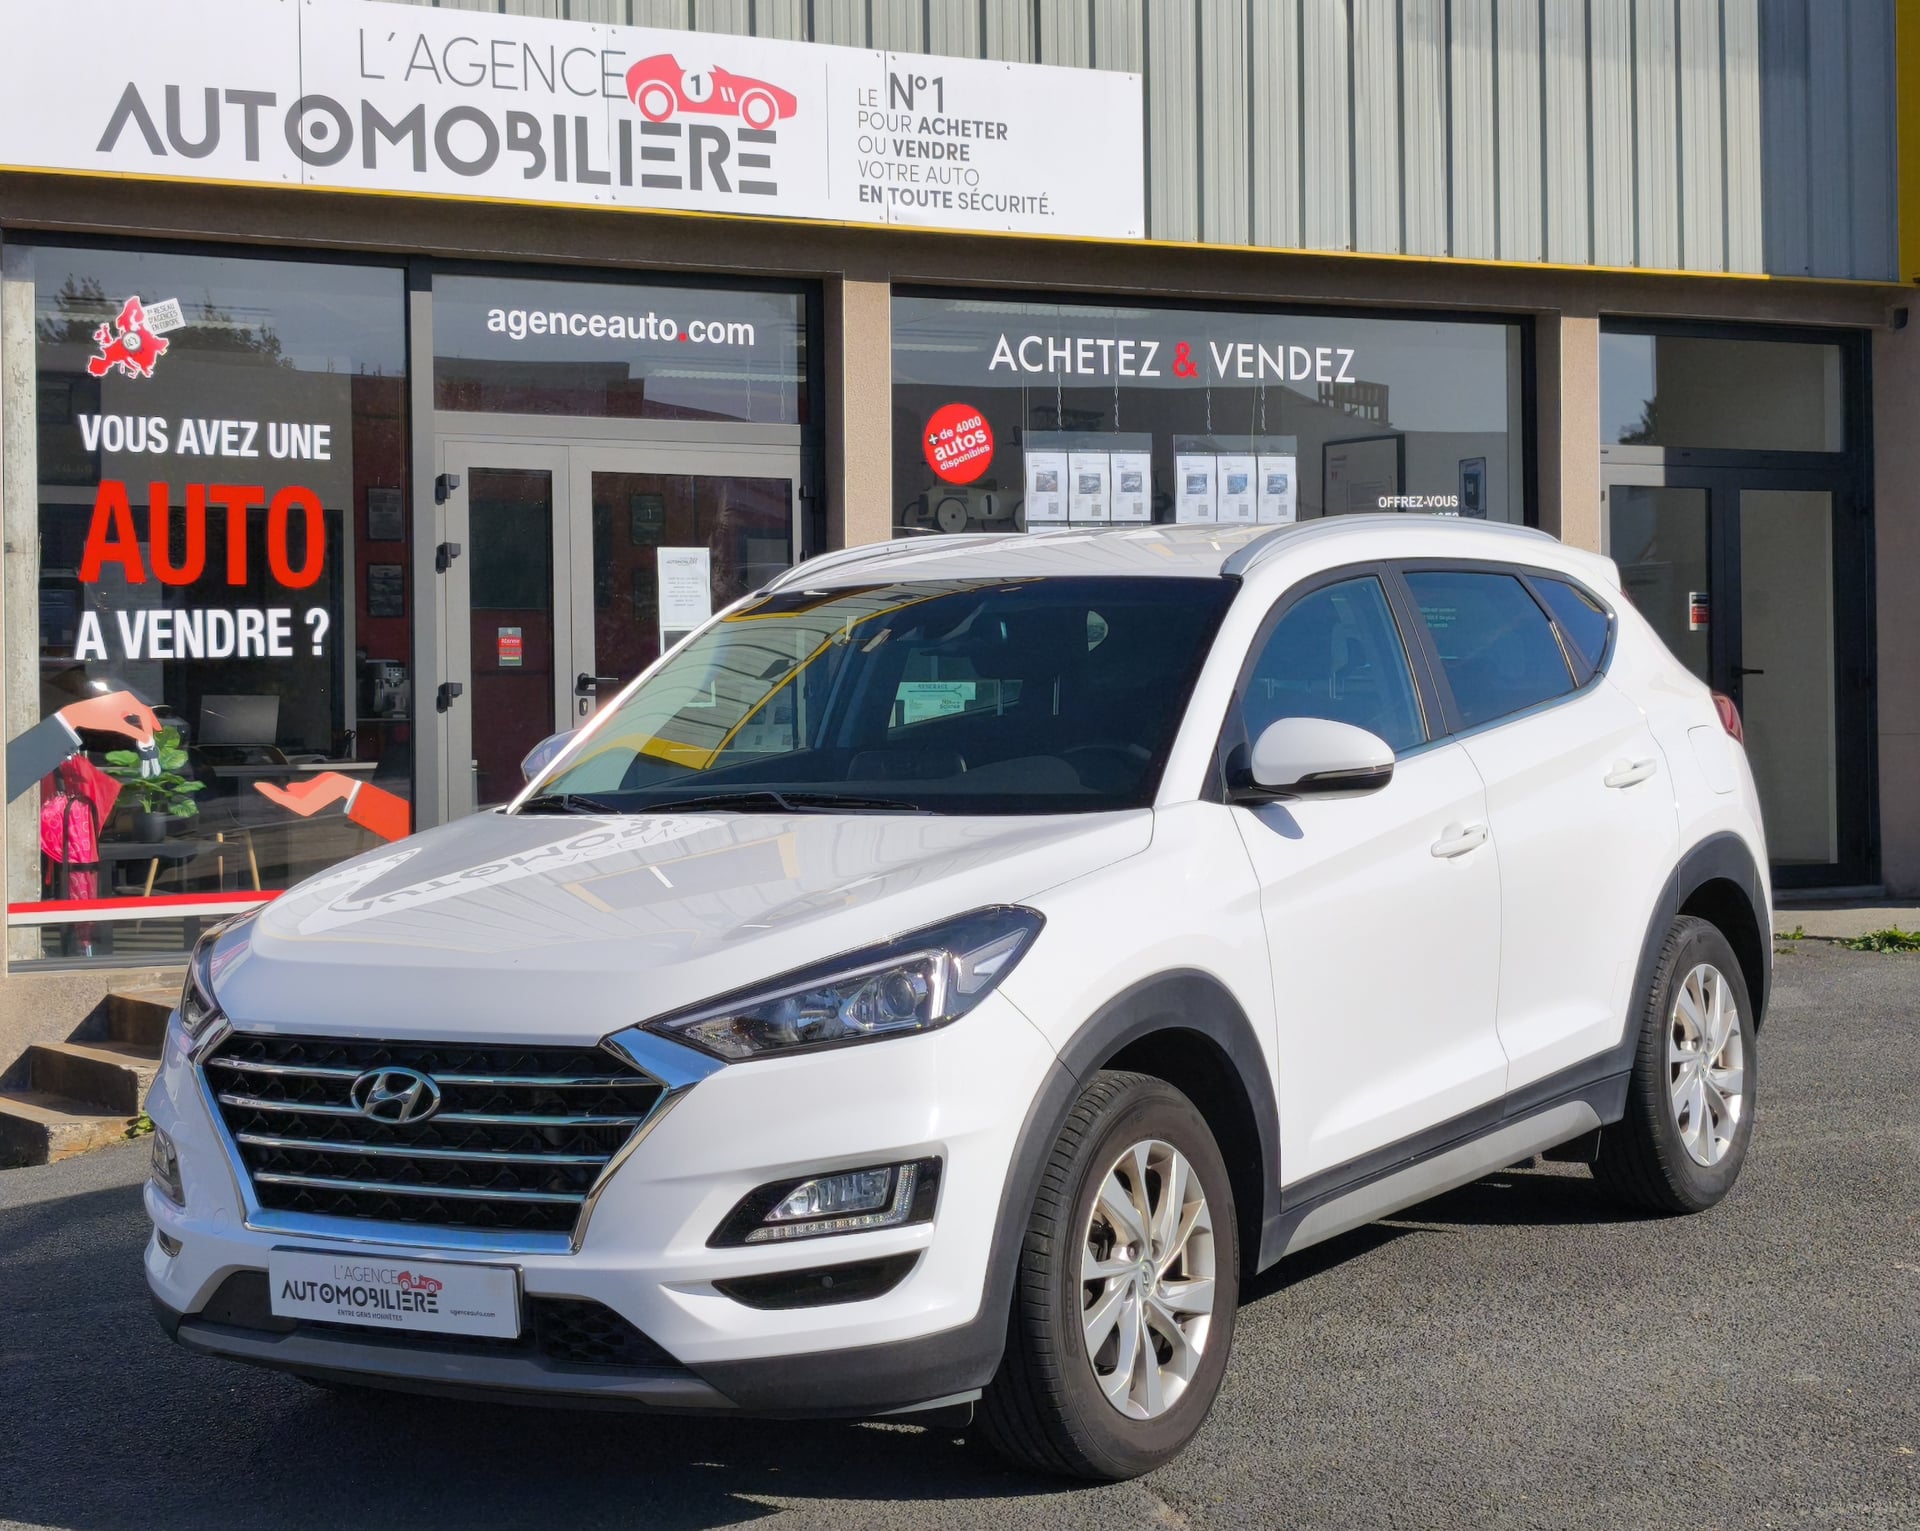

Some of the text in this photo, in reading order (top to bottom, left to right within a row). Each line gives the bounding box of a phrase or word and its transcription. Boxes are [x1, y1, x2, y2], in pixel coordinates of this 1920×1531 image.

[360, 28, 628, 99] L'AGENCE
[690, 74, 701, 96] 1
[858, 87, 878, 107] LE
[96, 81, 778, 196] AUTOMOBILIERE
[858, 111, 1008, 140] POUR ACHETER
[858, 135, 970, 162] OU VENDRE
[858, 160, 980, 187] VOTRE AUTO
[859, 184, 1055, 216] EN TOUTE SÉCURITÉ.
[487, 307, 755, 346] agenceauto.com
[988, 332, 1356, 384] ACHETEZ & VENDEZ
[78, 414, 331, 460] VOUS AVEZ UNE
[940, 428, 954, 440] de
[956, 415, 982, 434] 4000
[934, 429, 987, 461] autos
[940, 444, 990, 471] disponibles
[1378, 494, 1459, 508] OFFREZ-VOUS
[78, 479, 326, 589] AUTO
[75, 607, 330, 660] A VENDRE ?
[333, 1264, 398, 1285] L'AGENCE
[281, 1279, 439, 1314] AUTOMOBILIERE
